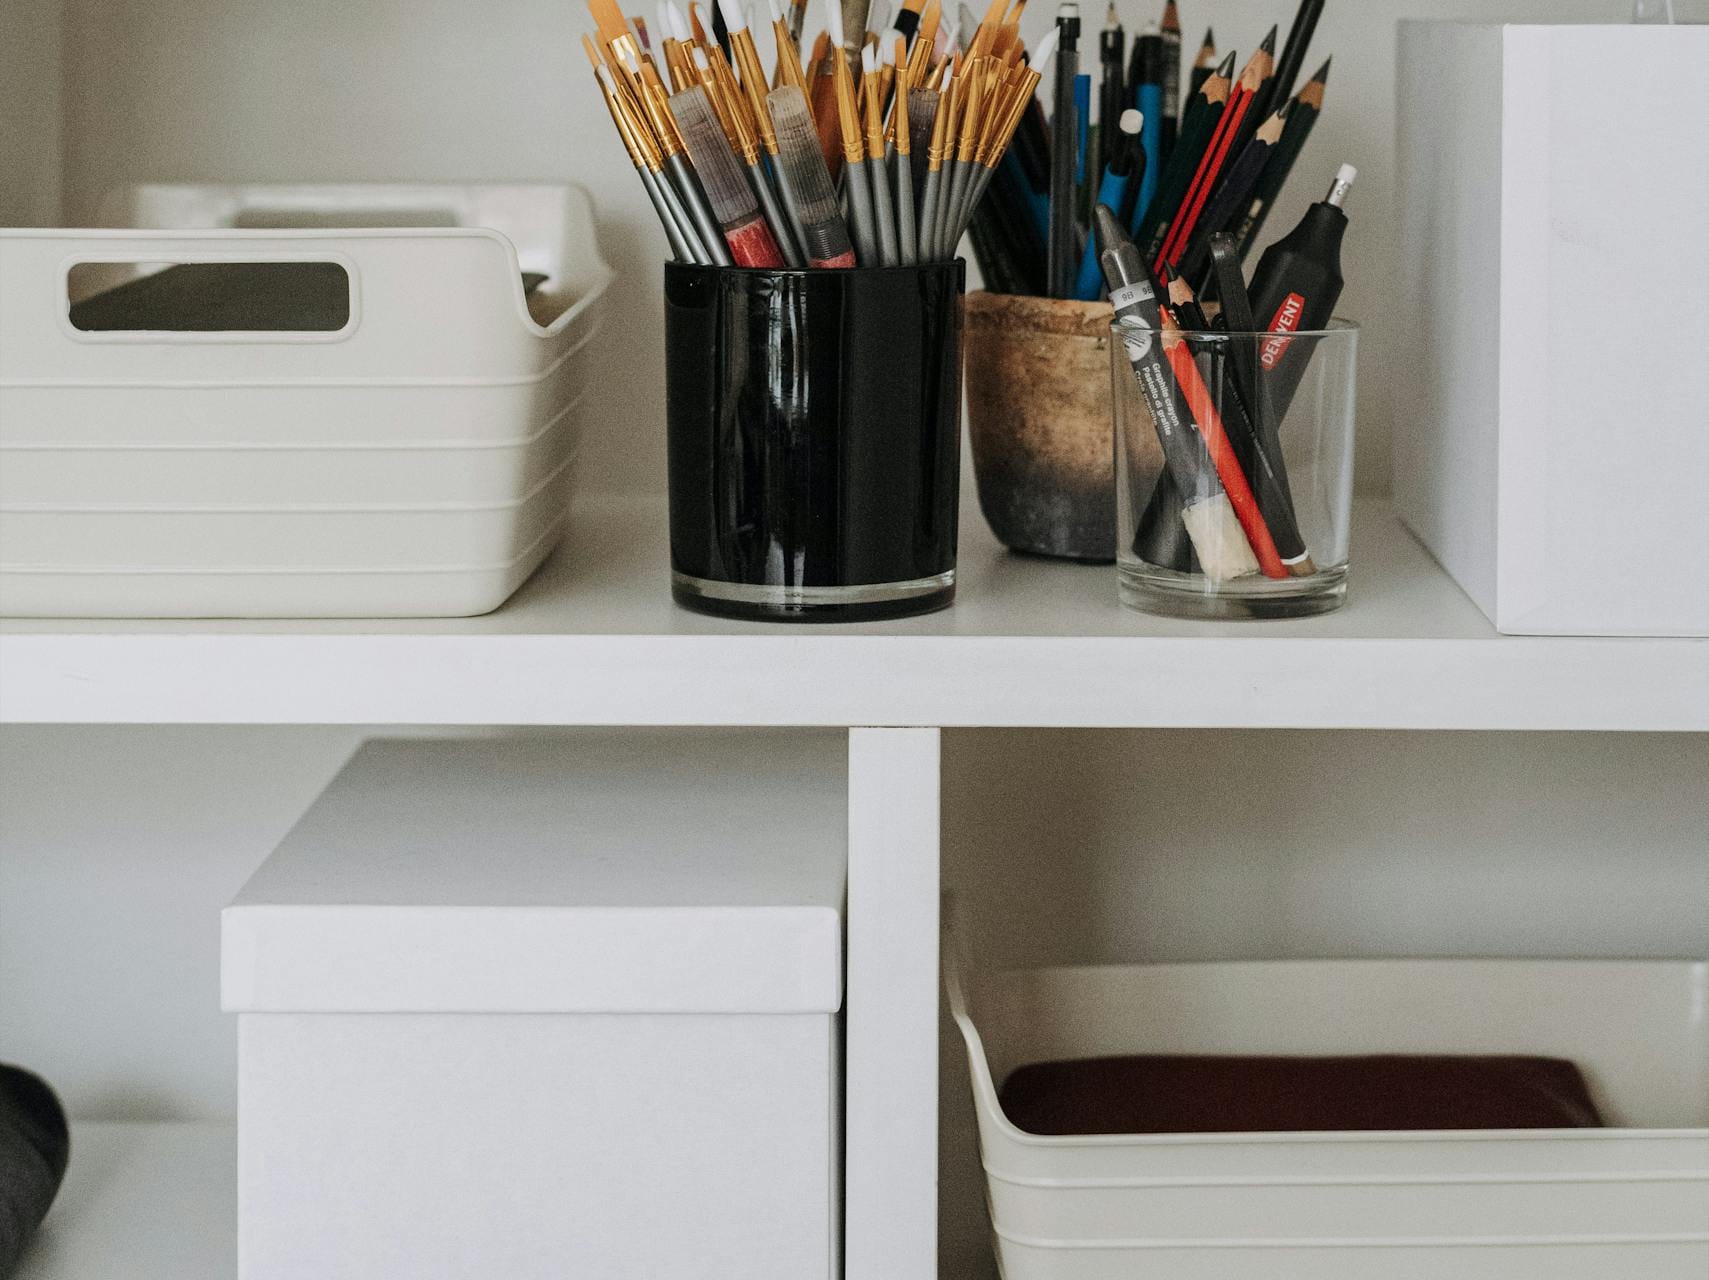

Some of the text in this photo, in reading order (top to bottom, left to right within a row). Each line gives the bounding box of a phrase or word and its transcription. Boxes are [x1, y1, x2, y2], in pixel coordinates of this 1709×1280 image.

[1142, 366, 1172, 436] Pastello di grafite
[1152, 362, 1180, 427] Graphite crayon
